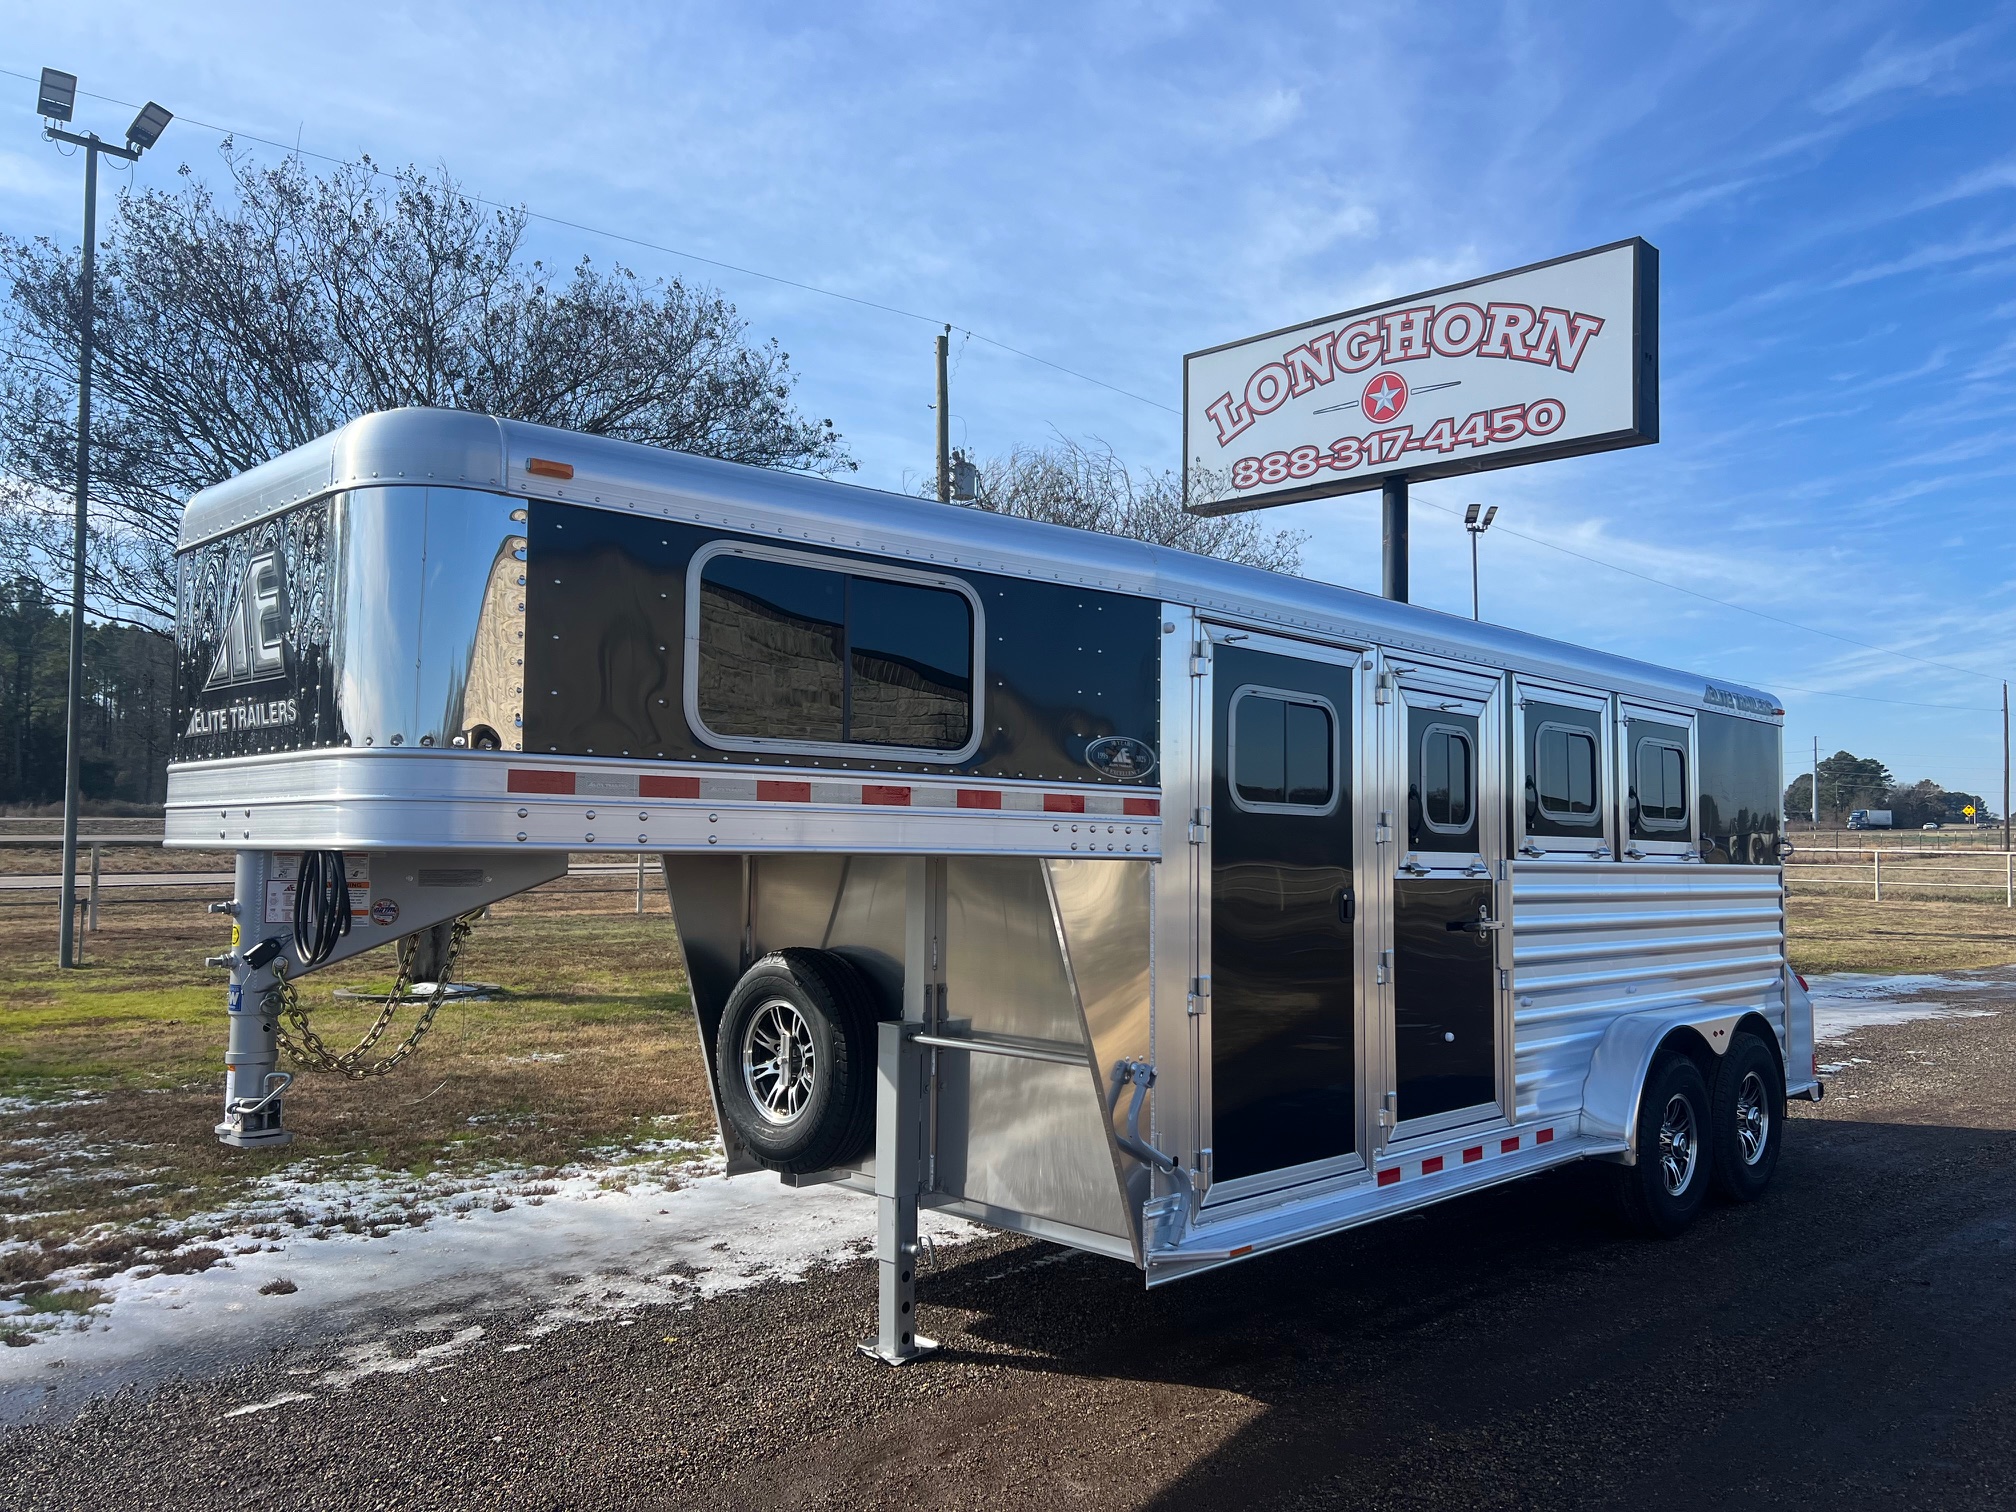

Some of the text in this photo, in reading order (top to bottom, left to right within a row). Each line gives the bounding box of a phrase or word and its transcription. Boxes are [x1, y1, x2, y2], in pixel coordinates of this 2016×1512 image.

[1206, 302, 1606, 448] LONGHORN
[1231, 398, 1566, 490] 888-317-4450
[184, 698, 297, 739] ELITE TRAILERS
